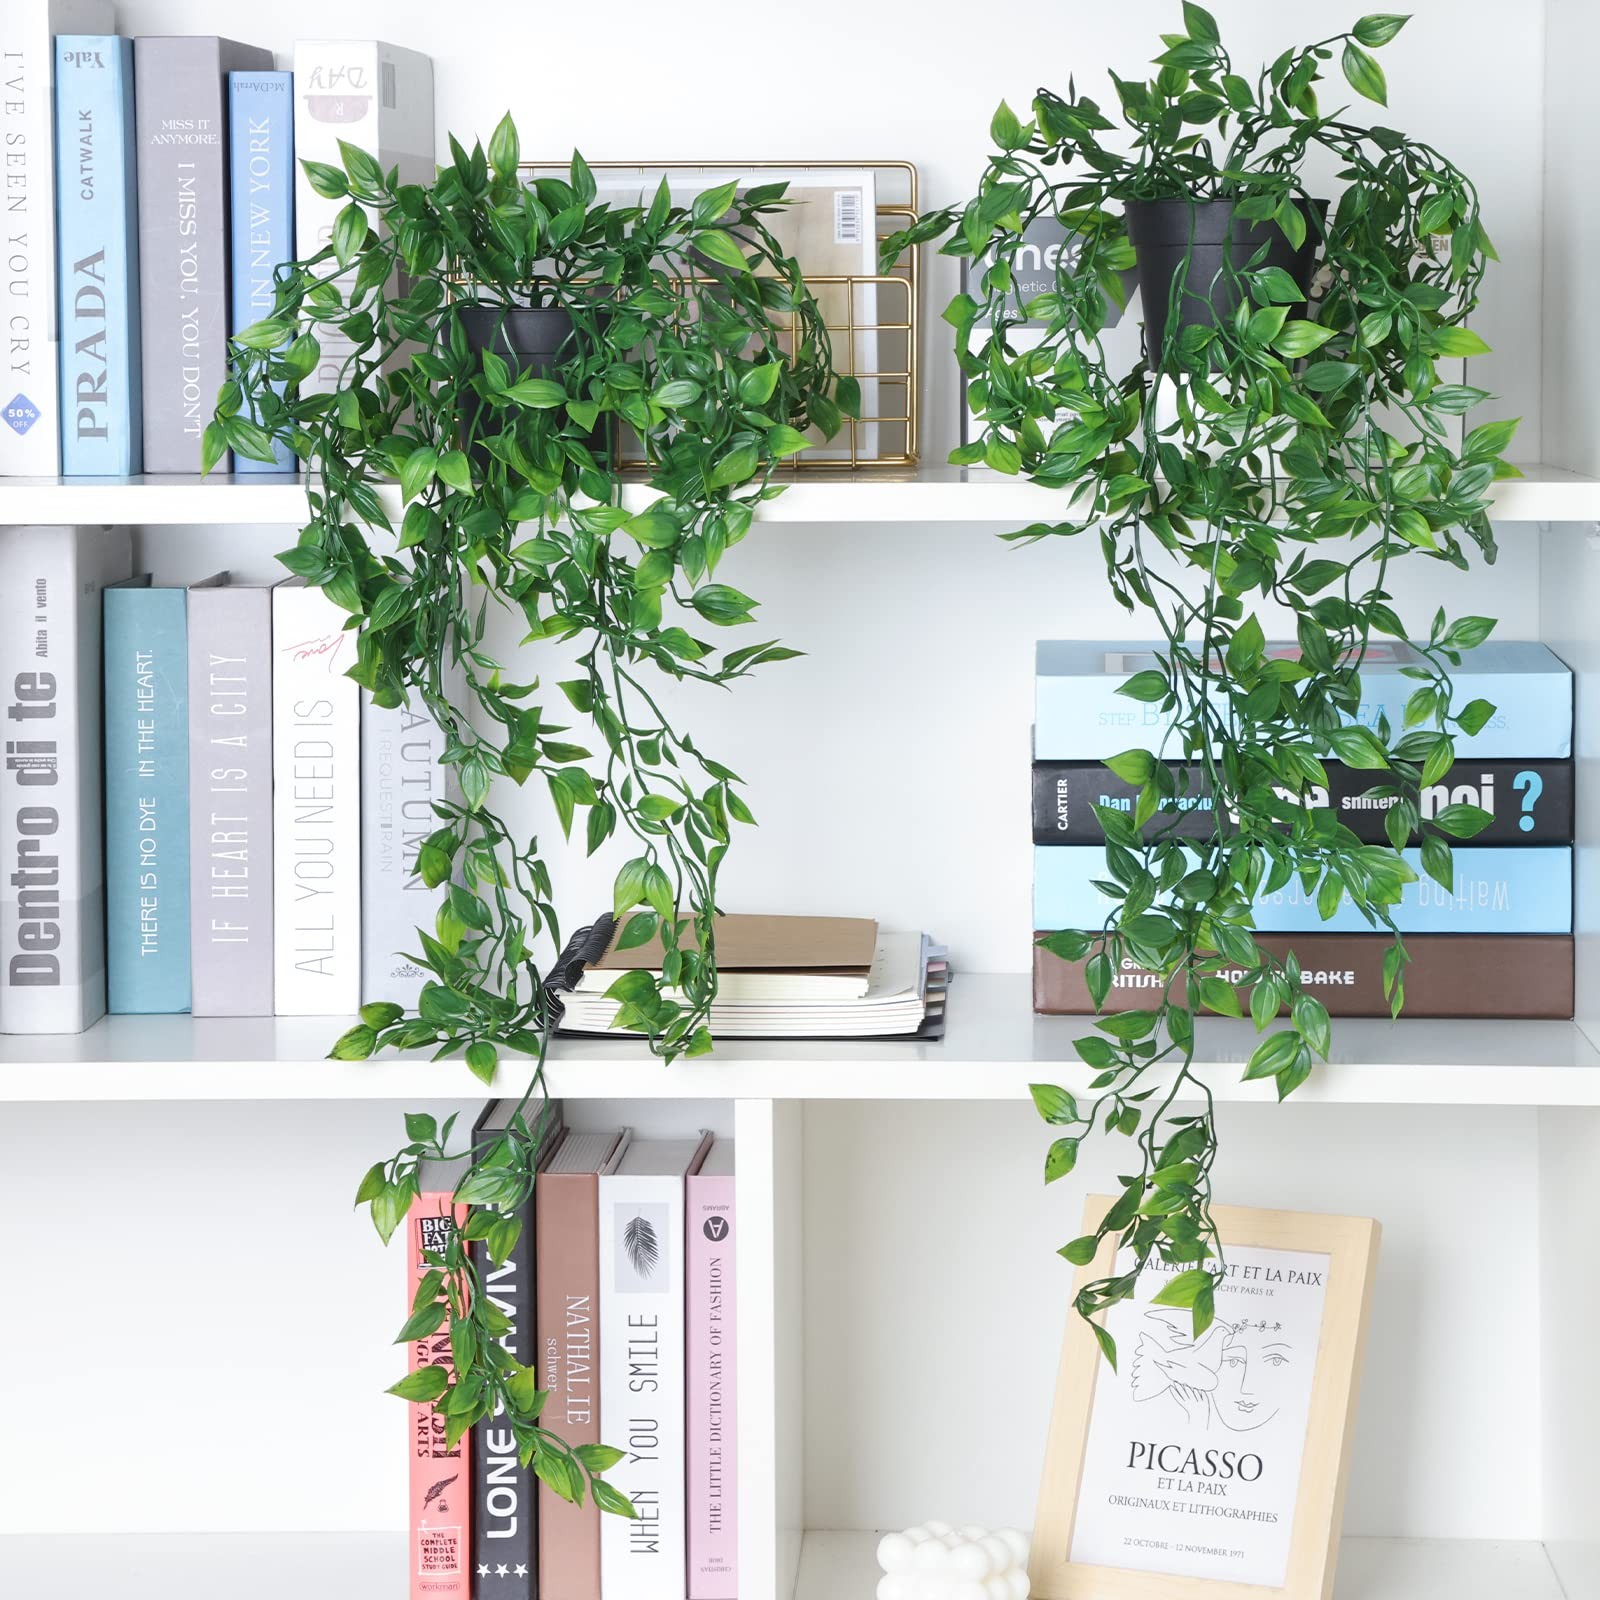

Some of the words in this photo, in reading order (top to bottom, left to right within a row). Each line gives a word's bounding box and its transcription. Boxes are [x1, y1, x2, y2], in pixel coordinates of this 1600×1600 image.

[63, 51, 105, 69] Yale
[4, 52, 25, 115] I'VE
[150, 133, 221, 145] ANYMORE.
[161, 119, 194, 130] MISS
[198, 119, 211, 130] IT
[6, 133, 27, 212] SEEN
[78, 109, 94, 201] CATWALK
[249, 116, 271, 191] YORK
[178, 177, 196, 236] MISS
[250, 203, 271, 268] NEW
[8, 233, 29, 297] YOU
[180, 242, 198, 300] YOU.
[251, 278, 271, 307] IN
[10, 315, 30, 375] CRY
[73, 246, 109, 442] PRADA
[181, 306, 200, 360] YOU
[8, 408, 36, 419] 50%
[13, 420, 29, 428] OFF
[34, 578, 47, 609] vento
[35, 629, 48, 658] Abita
[7, 671, 57, 722] te
[136, 649, 154, 712] HEART.
[209, 653, 248, 715] CITY
[293, 700, 334, 726] IS
[1098, 712, 1136, 726] STEP
[137, 719, 155, 754] THE
[210, 735, 248, 748] A
[6, 740, 59, 786] di
[138, 760, 155, 777] IN
[210, 767, 248, 793] IS
[293, 740, 334, 824] NEED
[138, 797, 156, 831] DYE
[1056, 778, 1069, 833] CARTIER
[1512, 770, 1544, 833] ?
[140, 838, 157, 866] NO
[211, 812, 249, 898] HEART
[294, 838, 335, 902] YOU
[9, 806, 61, 987] Dentro
[140, 873, 157, 889] IS
[140, 896, 158, 957] THERE
[211, 919, 249, 943] IF
[294, 914, 335, 977] ALL
[1299, 970, 1355, 985] BAKE
[709, 1257, 722, 1321] FASHION
[1240, 1286, 1264, 1296] PARIS
[1243, 1265, 1262, 1279] ET
[1265, 1268, 1283, 1282] LA
[1287, 1270, 1323, 1286] PAIX
[628, 1314, 658, 1393] SMILE
[709, 1326, 722, 1346] OF
[546, 1338, 561, 1393] schwer
[566, 1295, 591, 1425] NATHALIE
[709, 1350, 722, 1443] DICTIONARY
[417, 1411, 430, 1458] ARTS
[629, 1418, 659, 1464] YOU
[486, 1428, 518, 1539] LONE
[709, 1447, 722, 1499] LITTLE
[1126, 1440, 1263, 1482] PICASSO
[1108, 1494, 1171, 1511] ORIGINAUX
[1172, 1501, 1187, 1513] ET
[1188, 1502, 1279, 1524] LITHOGRAPHIES
[1157, 1476, 1175, 1490] ET
[1177, 1478, 1194, 1493] LA
[1197, 1480, 1228, 1497] PAIX
[629, 1490, 660, 1553] WHEN
[709, 1502, 722, 1534] THE
[420, 1538, 458, 1546] COMPLETE
[423, 1546, 456, 1554] MIDDLE
[423, 1555, 456, 1563] SCHOOL
[1122, 1537, 1132, 1546] 22
[1133, 1538, 1169, 1550] OCTOBRE
[1175, 1543, 1184, 1552] 12
[1184, 1544, 1228, 1557] NOVEMBER
